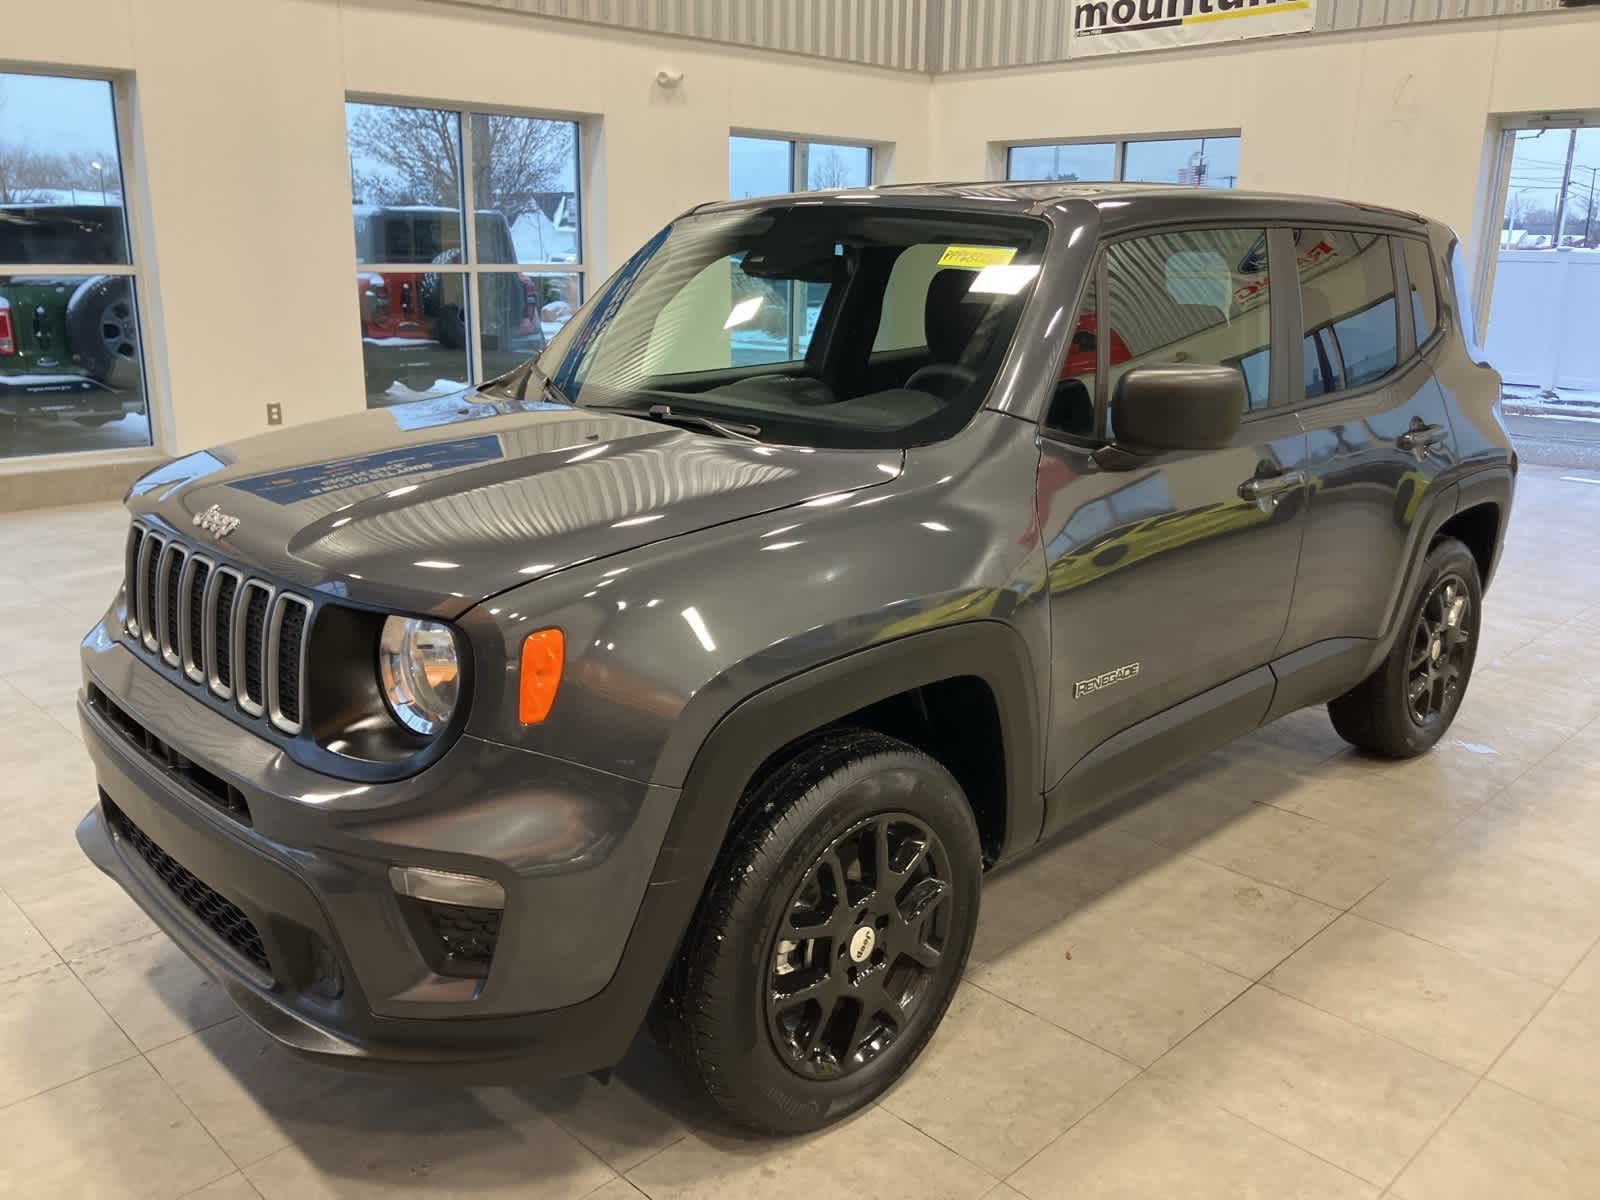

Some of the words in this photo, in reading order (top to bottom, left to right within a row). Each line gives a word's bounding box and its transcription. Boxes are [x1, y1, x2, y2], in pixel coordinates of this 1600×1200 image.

[1074, 0, 1297, 29] moun
[192, 504, 240, 539] Jeep
[1074, 662, 1140, 699] RENEGADE
[856, 930, 872, 959] Jeep
